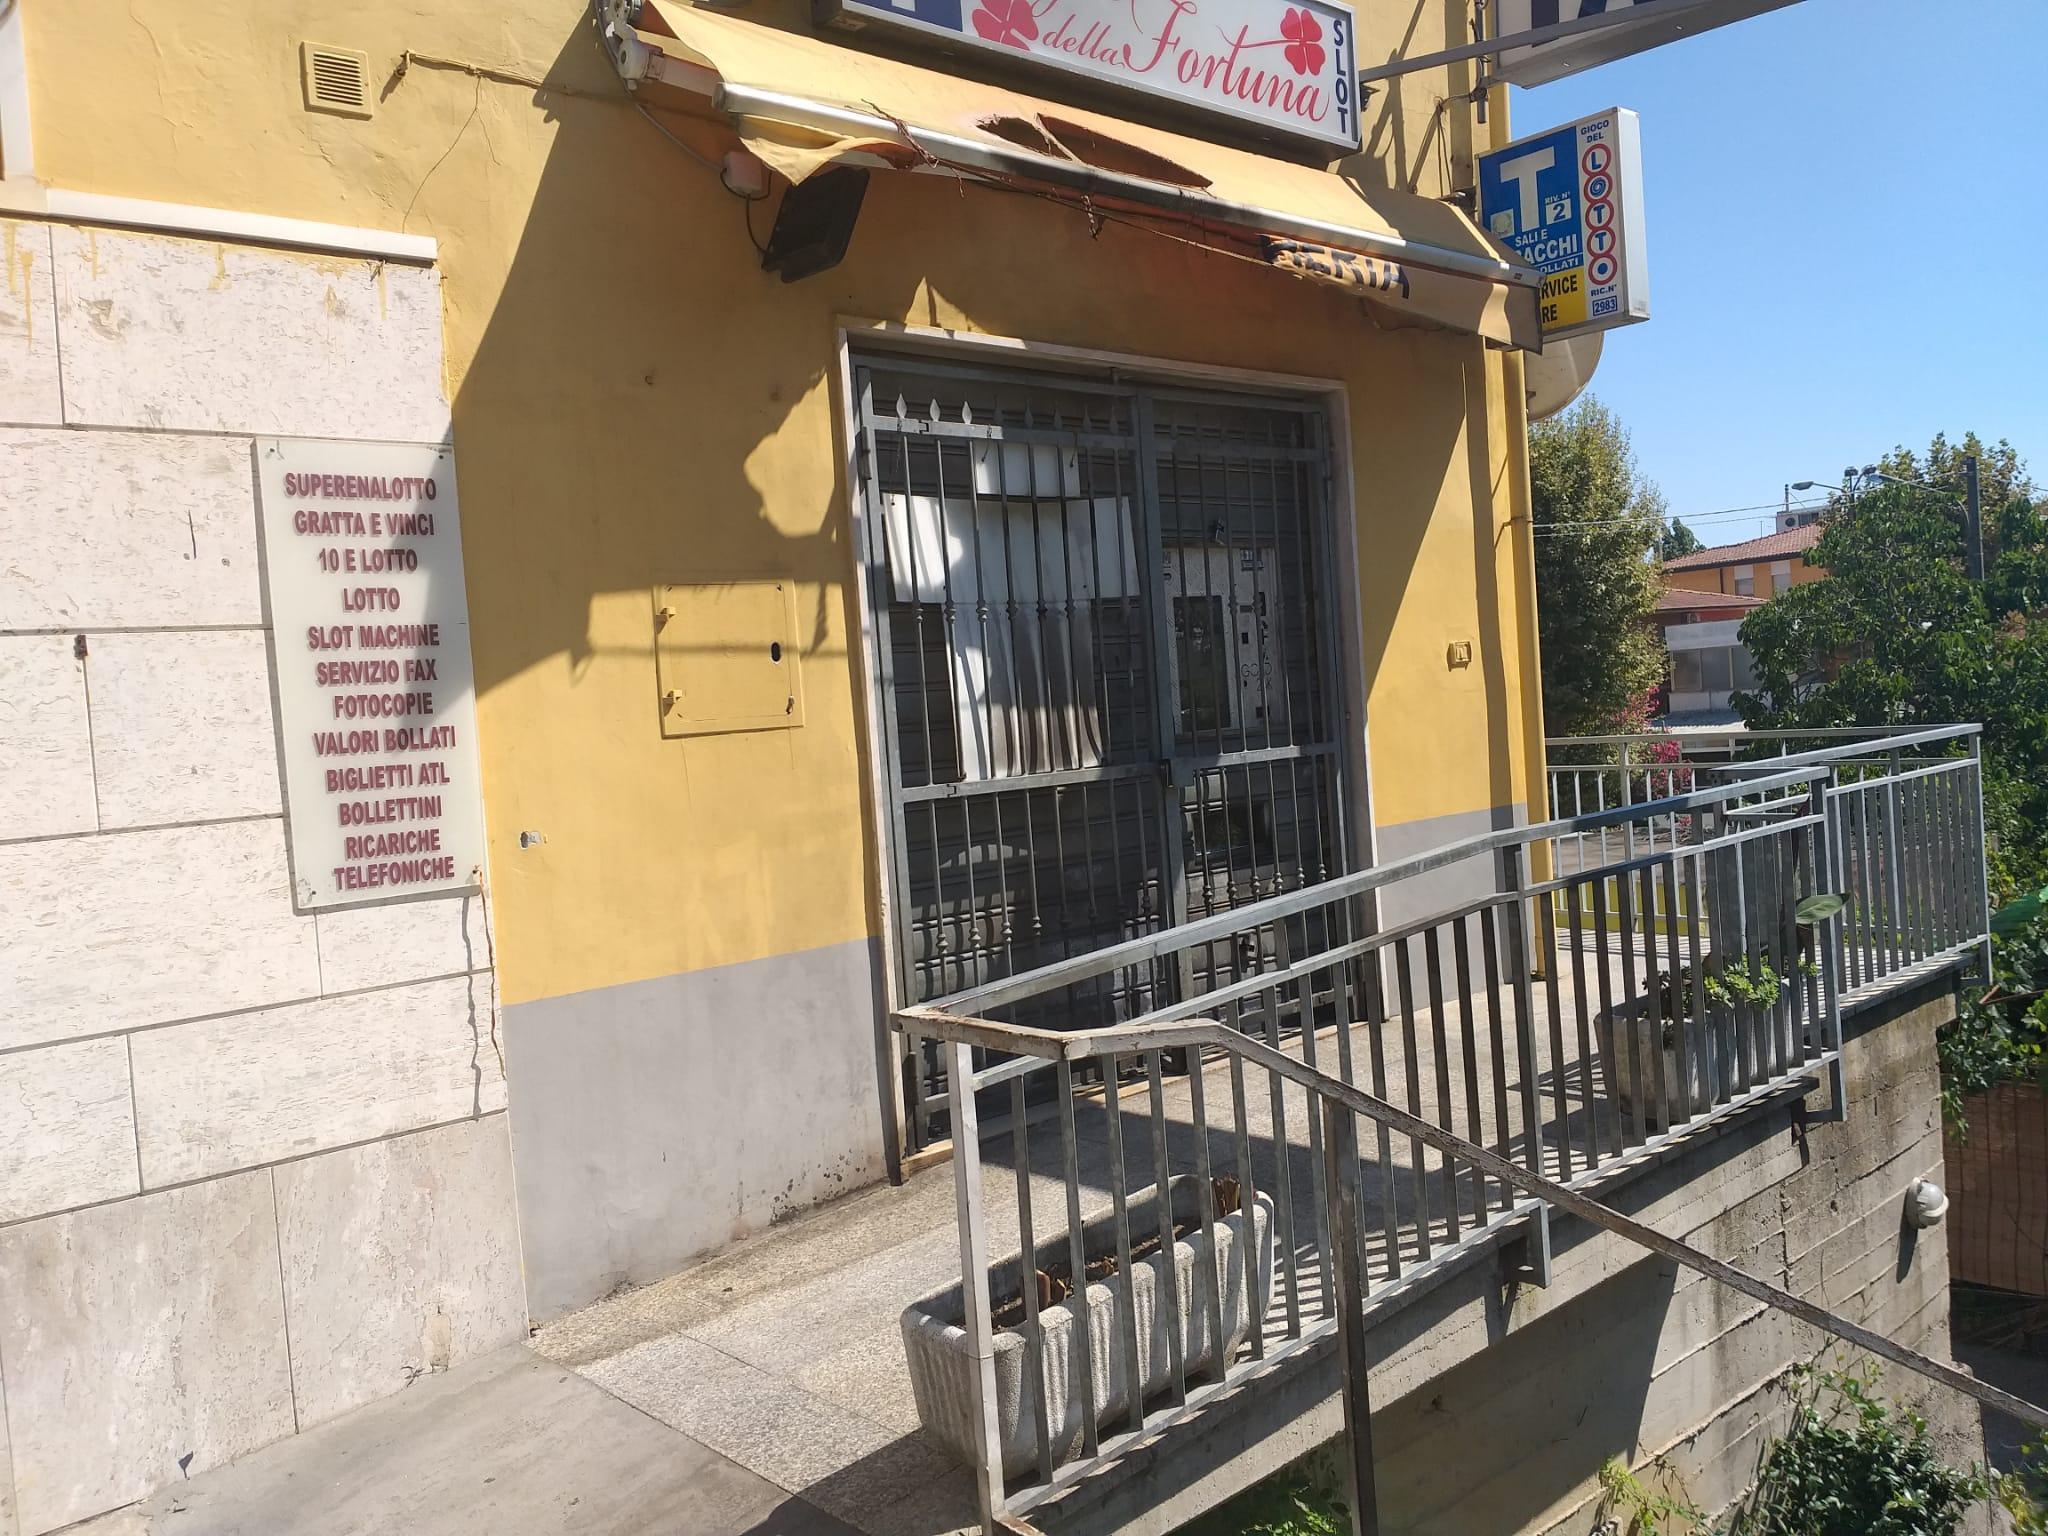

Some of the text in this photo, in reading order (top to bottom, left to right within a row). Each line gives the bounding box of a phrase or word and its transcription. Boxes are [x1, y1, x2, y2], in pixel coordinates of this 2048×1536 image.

[1042, 0, 1330, 122] della Fortuna
[1332, 19, 1349, 134] SLOT
[1580, 119, 1609, 135] GIOCO
[1586, 131, 1605, 143] DEL
[1500, 146, 1555, 232] T
[1552, 202, 1566, 221] 2
[1515, 228, 1548, 248] SALI E
[1516, 233, 1578, 265] ACCHI
[1540, 256, 1579, 274] OLLATI
[1541, 274, 1578, 300] RVICE
[1541, 303, 1558, 324] RE
[1594, 298, 1616, 314] 2983
[285, 472, 437, 501] SUPERENALOTTO
[294, 510, 435, 536] GRATTA E VINCI
[318, 548, 418, 572] 10 E LOTTO
[343, 587, 401, 611] LOTTO
[308, 624, 440, 650] SLOT MACHINE
[317, 659, 438, 685] SERVIZIO FAX
[334, 692, 434, 718] FOTOCOPIE
[314, 725, 456, 755] VALORI BOLLATI
[326, 762, 450, 792] BIGLIETTI ATL
[339, 795, 442, 826] BOLLETTINI
[345, 828, 441, 859] RICARICHE
[334, 856, 455, 890] TELEFONICHE
